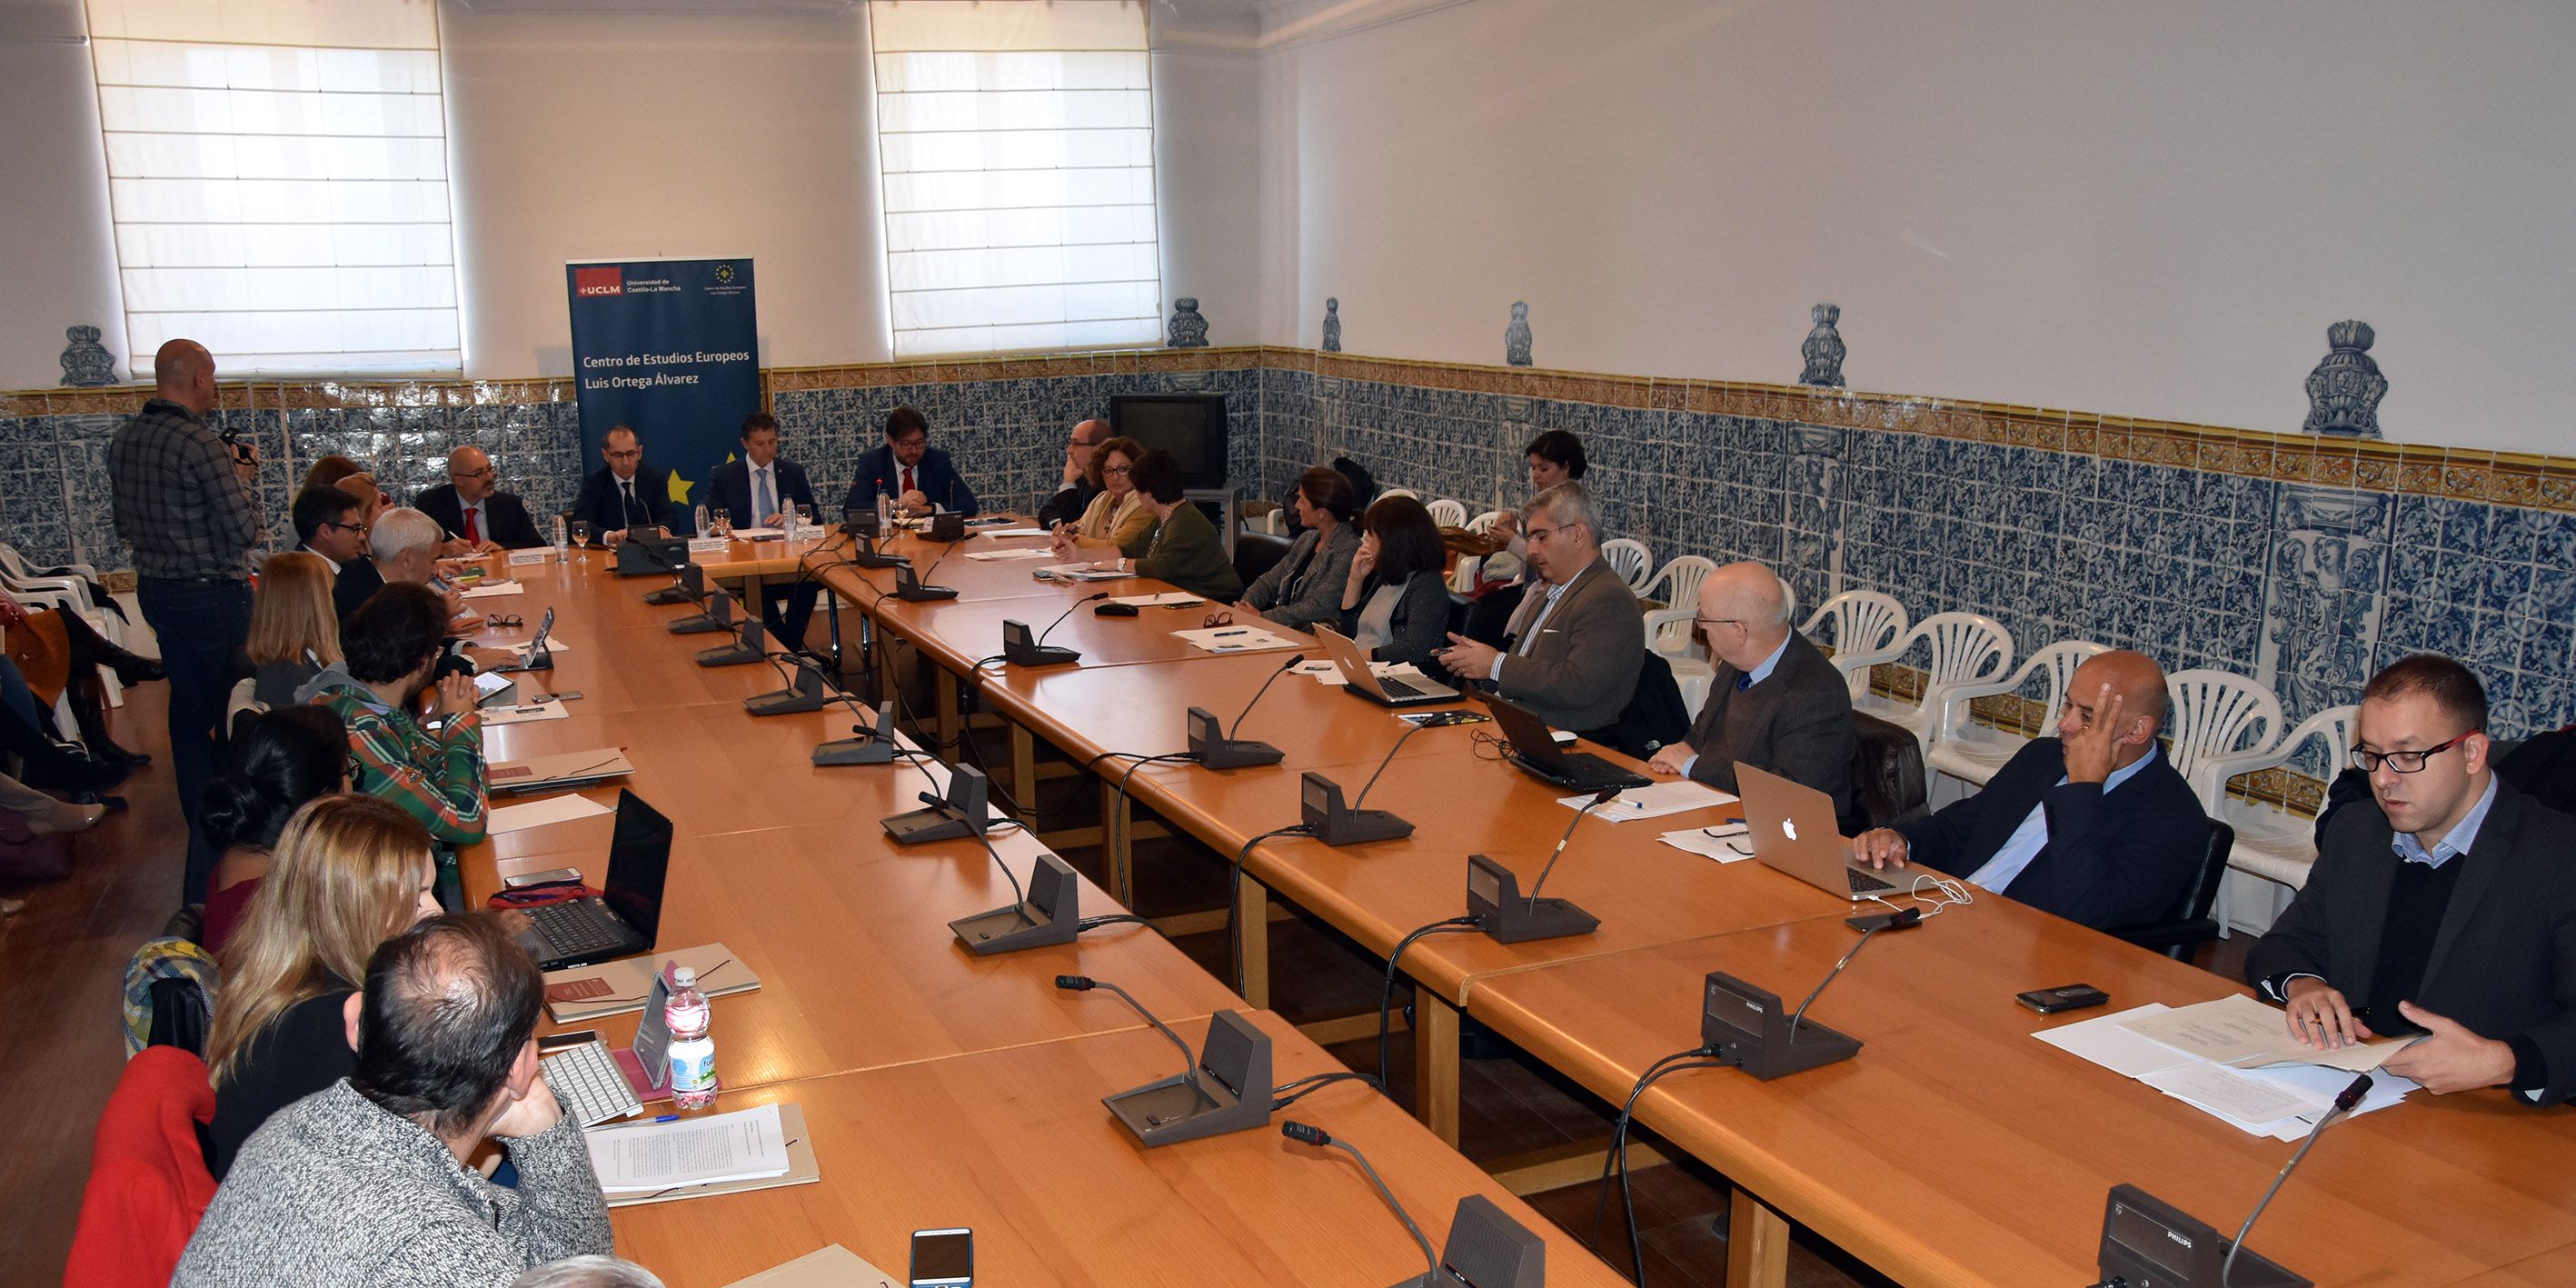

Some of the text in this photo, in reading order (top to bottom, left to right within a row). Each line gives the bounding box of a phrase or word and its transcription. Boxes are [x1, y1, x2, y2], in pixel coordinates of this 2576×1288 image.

[587, 286, 621, 295] UCLM
[583, 351, 750, 368] Centro de Estudios Europeos
[585, 372, 699, 390] Luis Ortega Álvarez
[2167, 1231, 2192, 1249] PHILIPS
